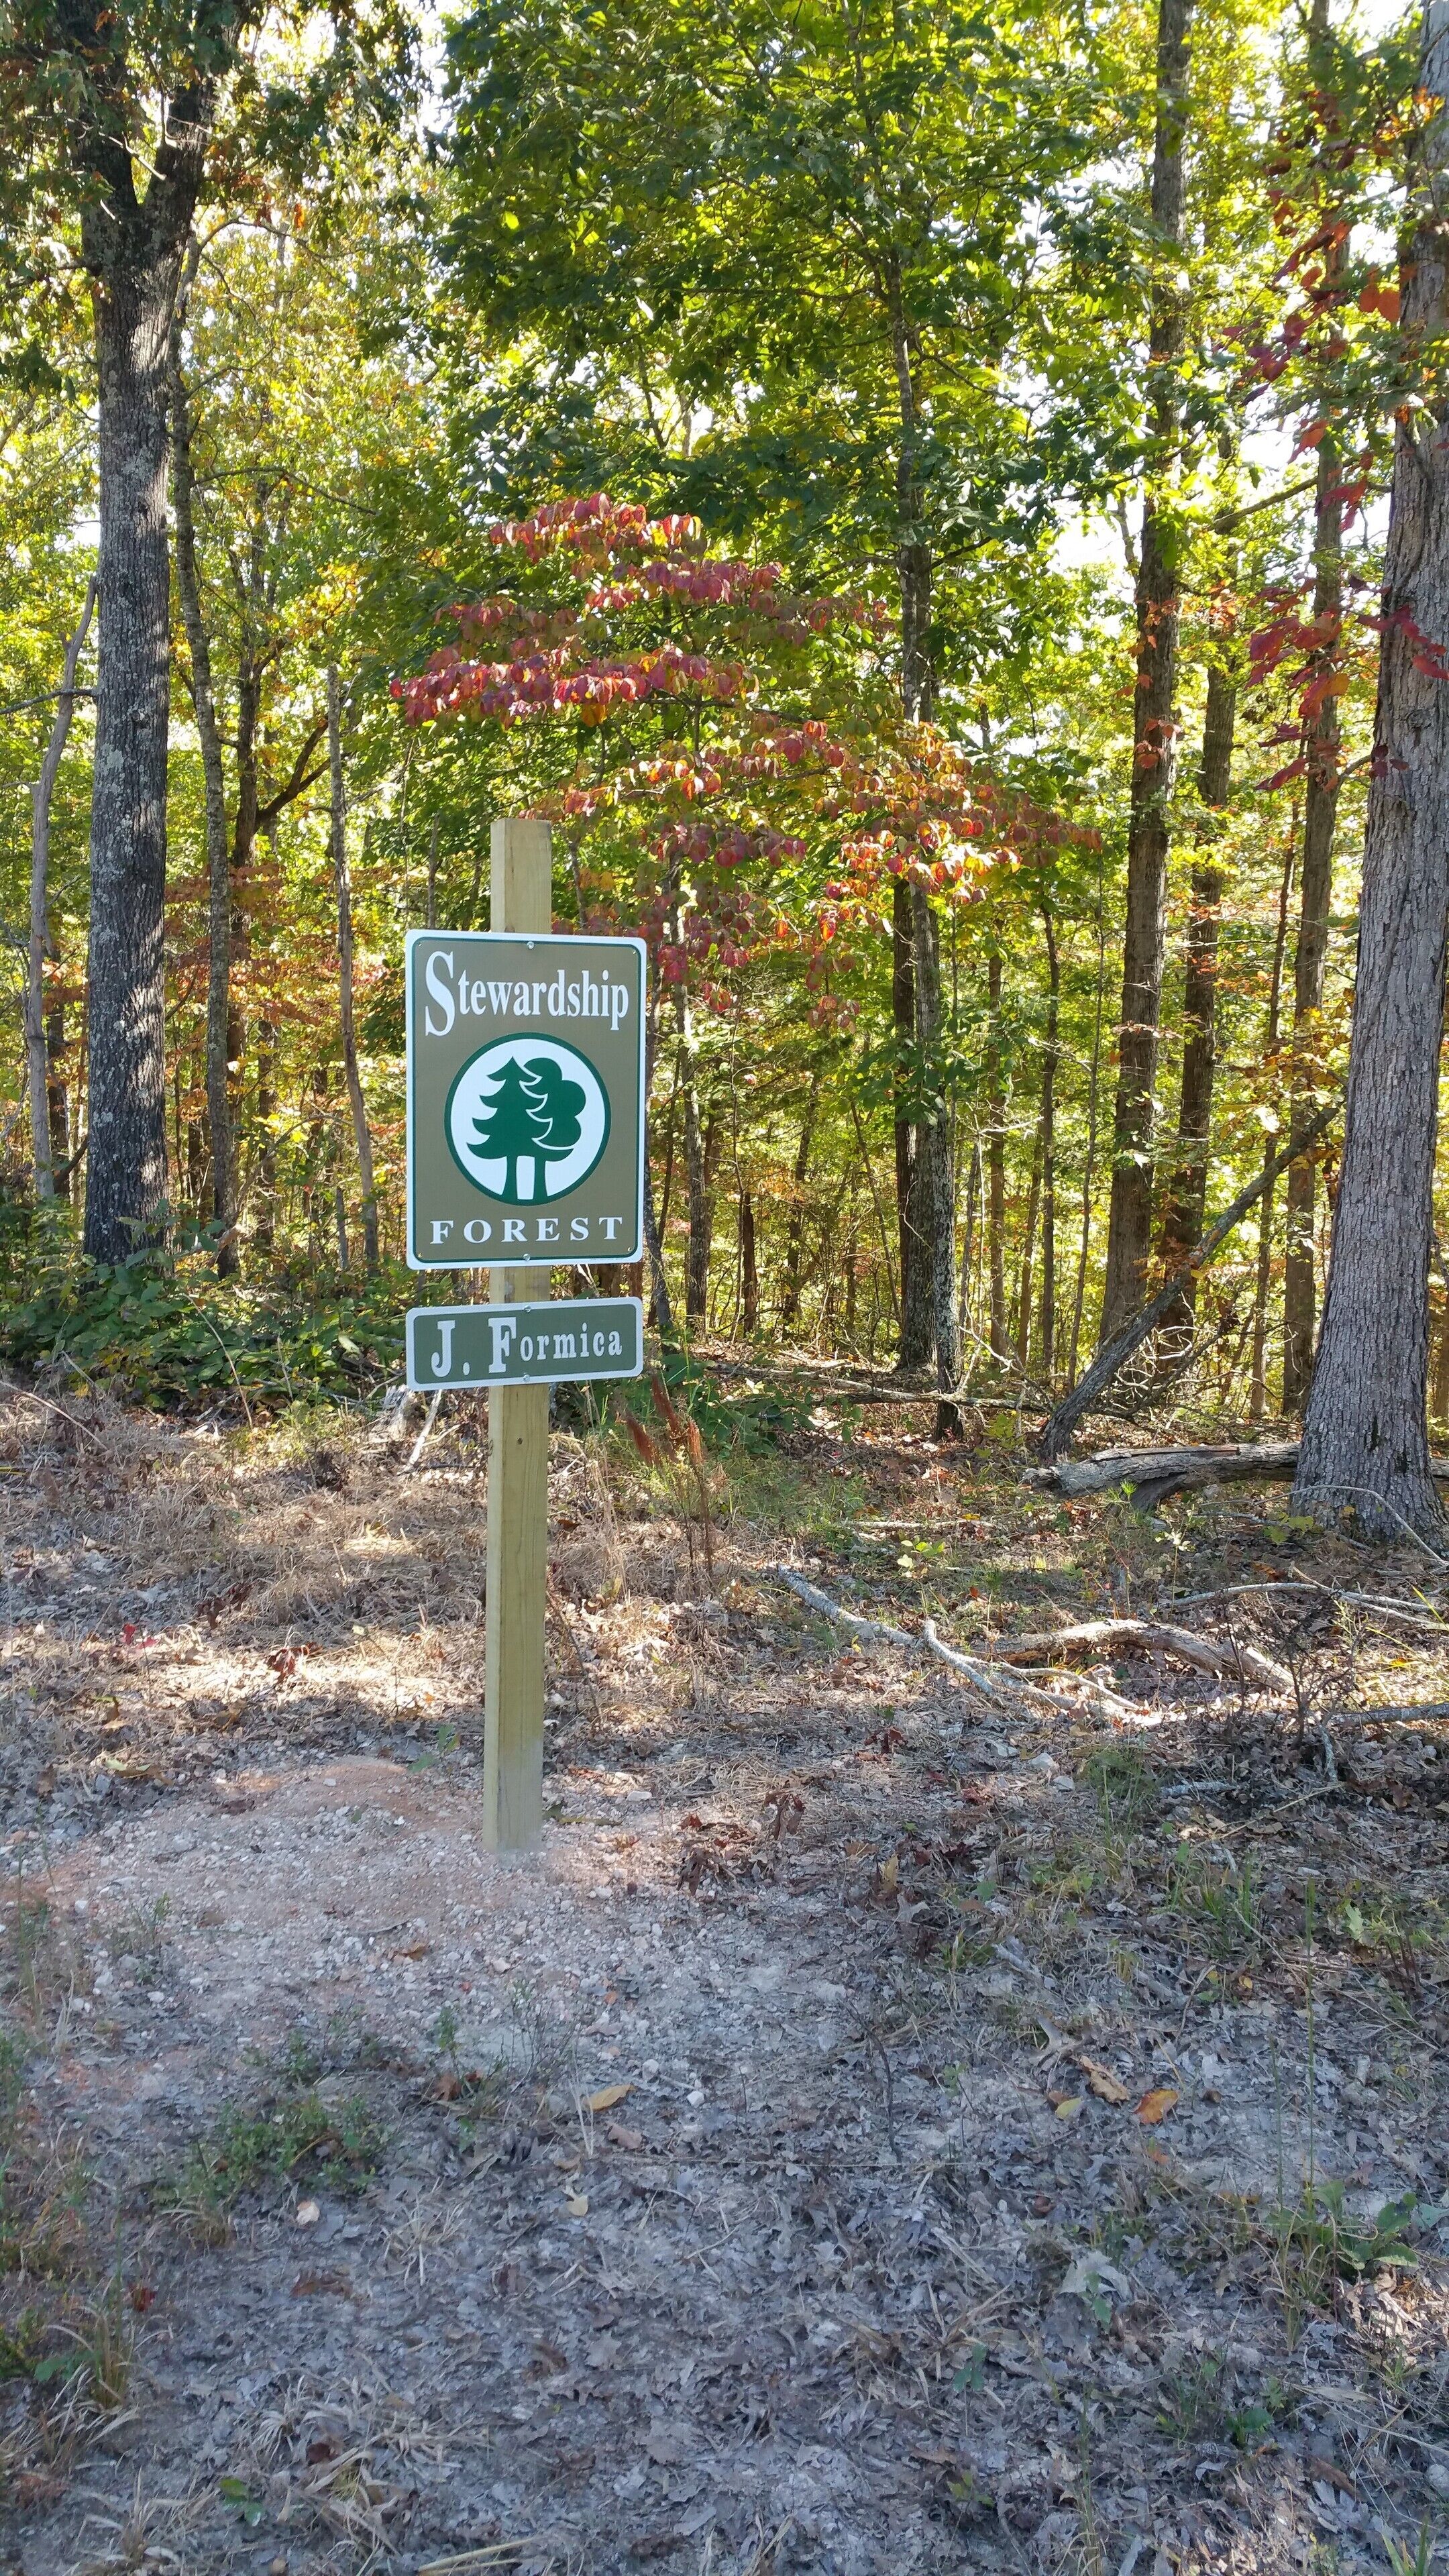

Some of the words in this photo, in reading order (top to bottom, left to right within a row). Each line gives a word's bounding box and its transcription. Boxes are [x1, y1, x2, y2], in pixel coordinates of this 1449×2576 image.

[425, 951, 629, 1036] Stewardship
[429, 1216, 623, 1244] FOREST
[431, 1320, 470, 1378] J.
[488, 1316, 623, 1374] Formica
